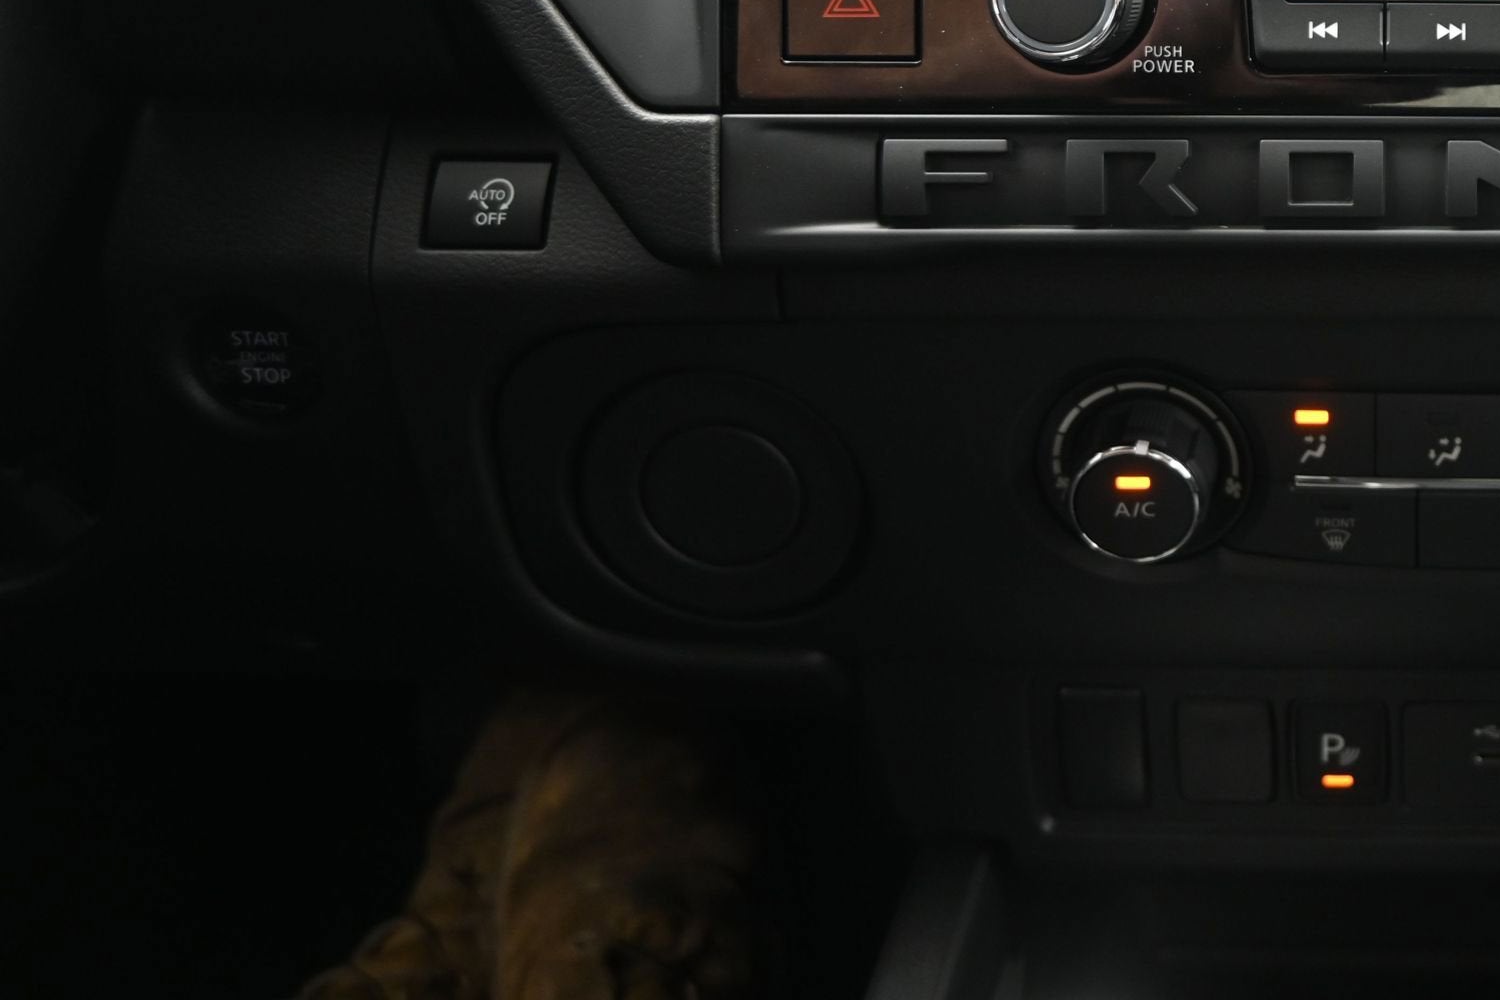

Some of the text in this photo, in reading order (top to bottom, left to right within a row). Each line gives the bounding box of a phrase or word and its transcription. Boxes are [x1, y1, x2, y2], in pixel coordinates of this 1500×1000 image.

[1144, 45, 1183, 58] PUSH
[1133, 60, 1195, 73] POWER
[468, 189, 506, 200] AUTO
[475, 212, 508, 225] OFF
[231, 330, 289, 347] START
[240, 367, 292, 384] STOP
[1114, 501, 1157, 518] A/C
[1315, 516, 1355, 527] FRONT
[1320, 732, 1346, 763] P
